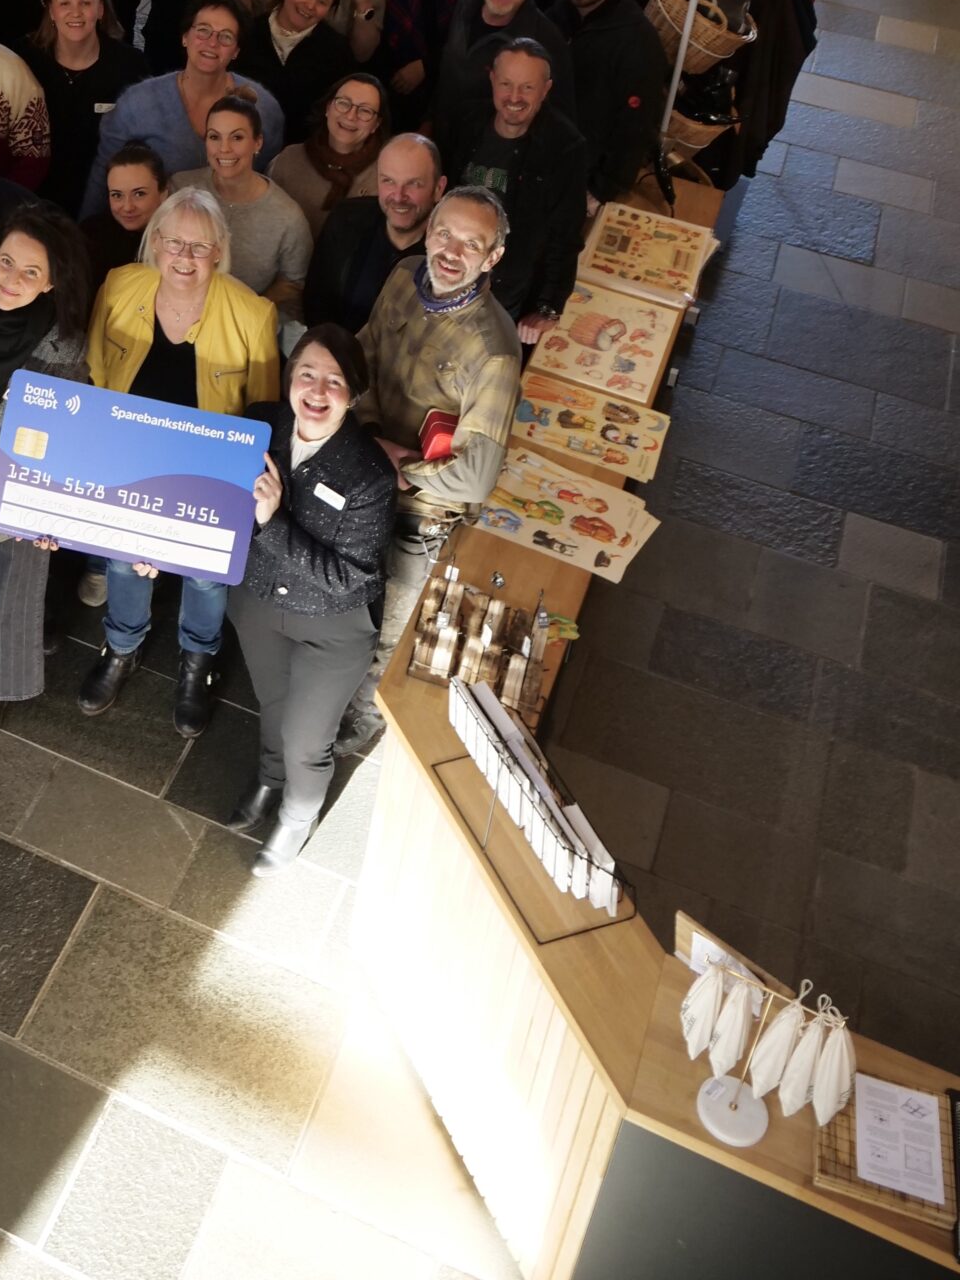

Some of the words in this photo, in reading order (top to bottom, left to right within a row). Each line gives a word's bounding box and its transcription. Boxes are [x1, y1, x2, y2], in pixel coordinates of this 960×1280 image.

[23, 394, 58, 409] axept
[25, 383, 56, 399] bank
[110, 405, 224, 440] Sparebankstiftelsen
[227, 430, 255, 445] SMN
[7, 464, 51, 486] 1234
[62, 477, 105, 499] 5678
[118, 489, 164, 513] 9012
[175, 502, 220, 525] 3456
